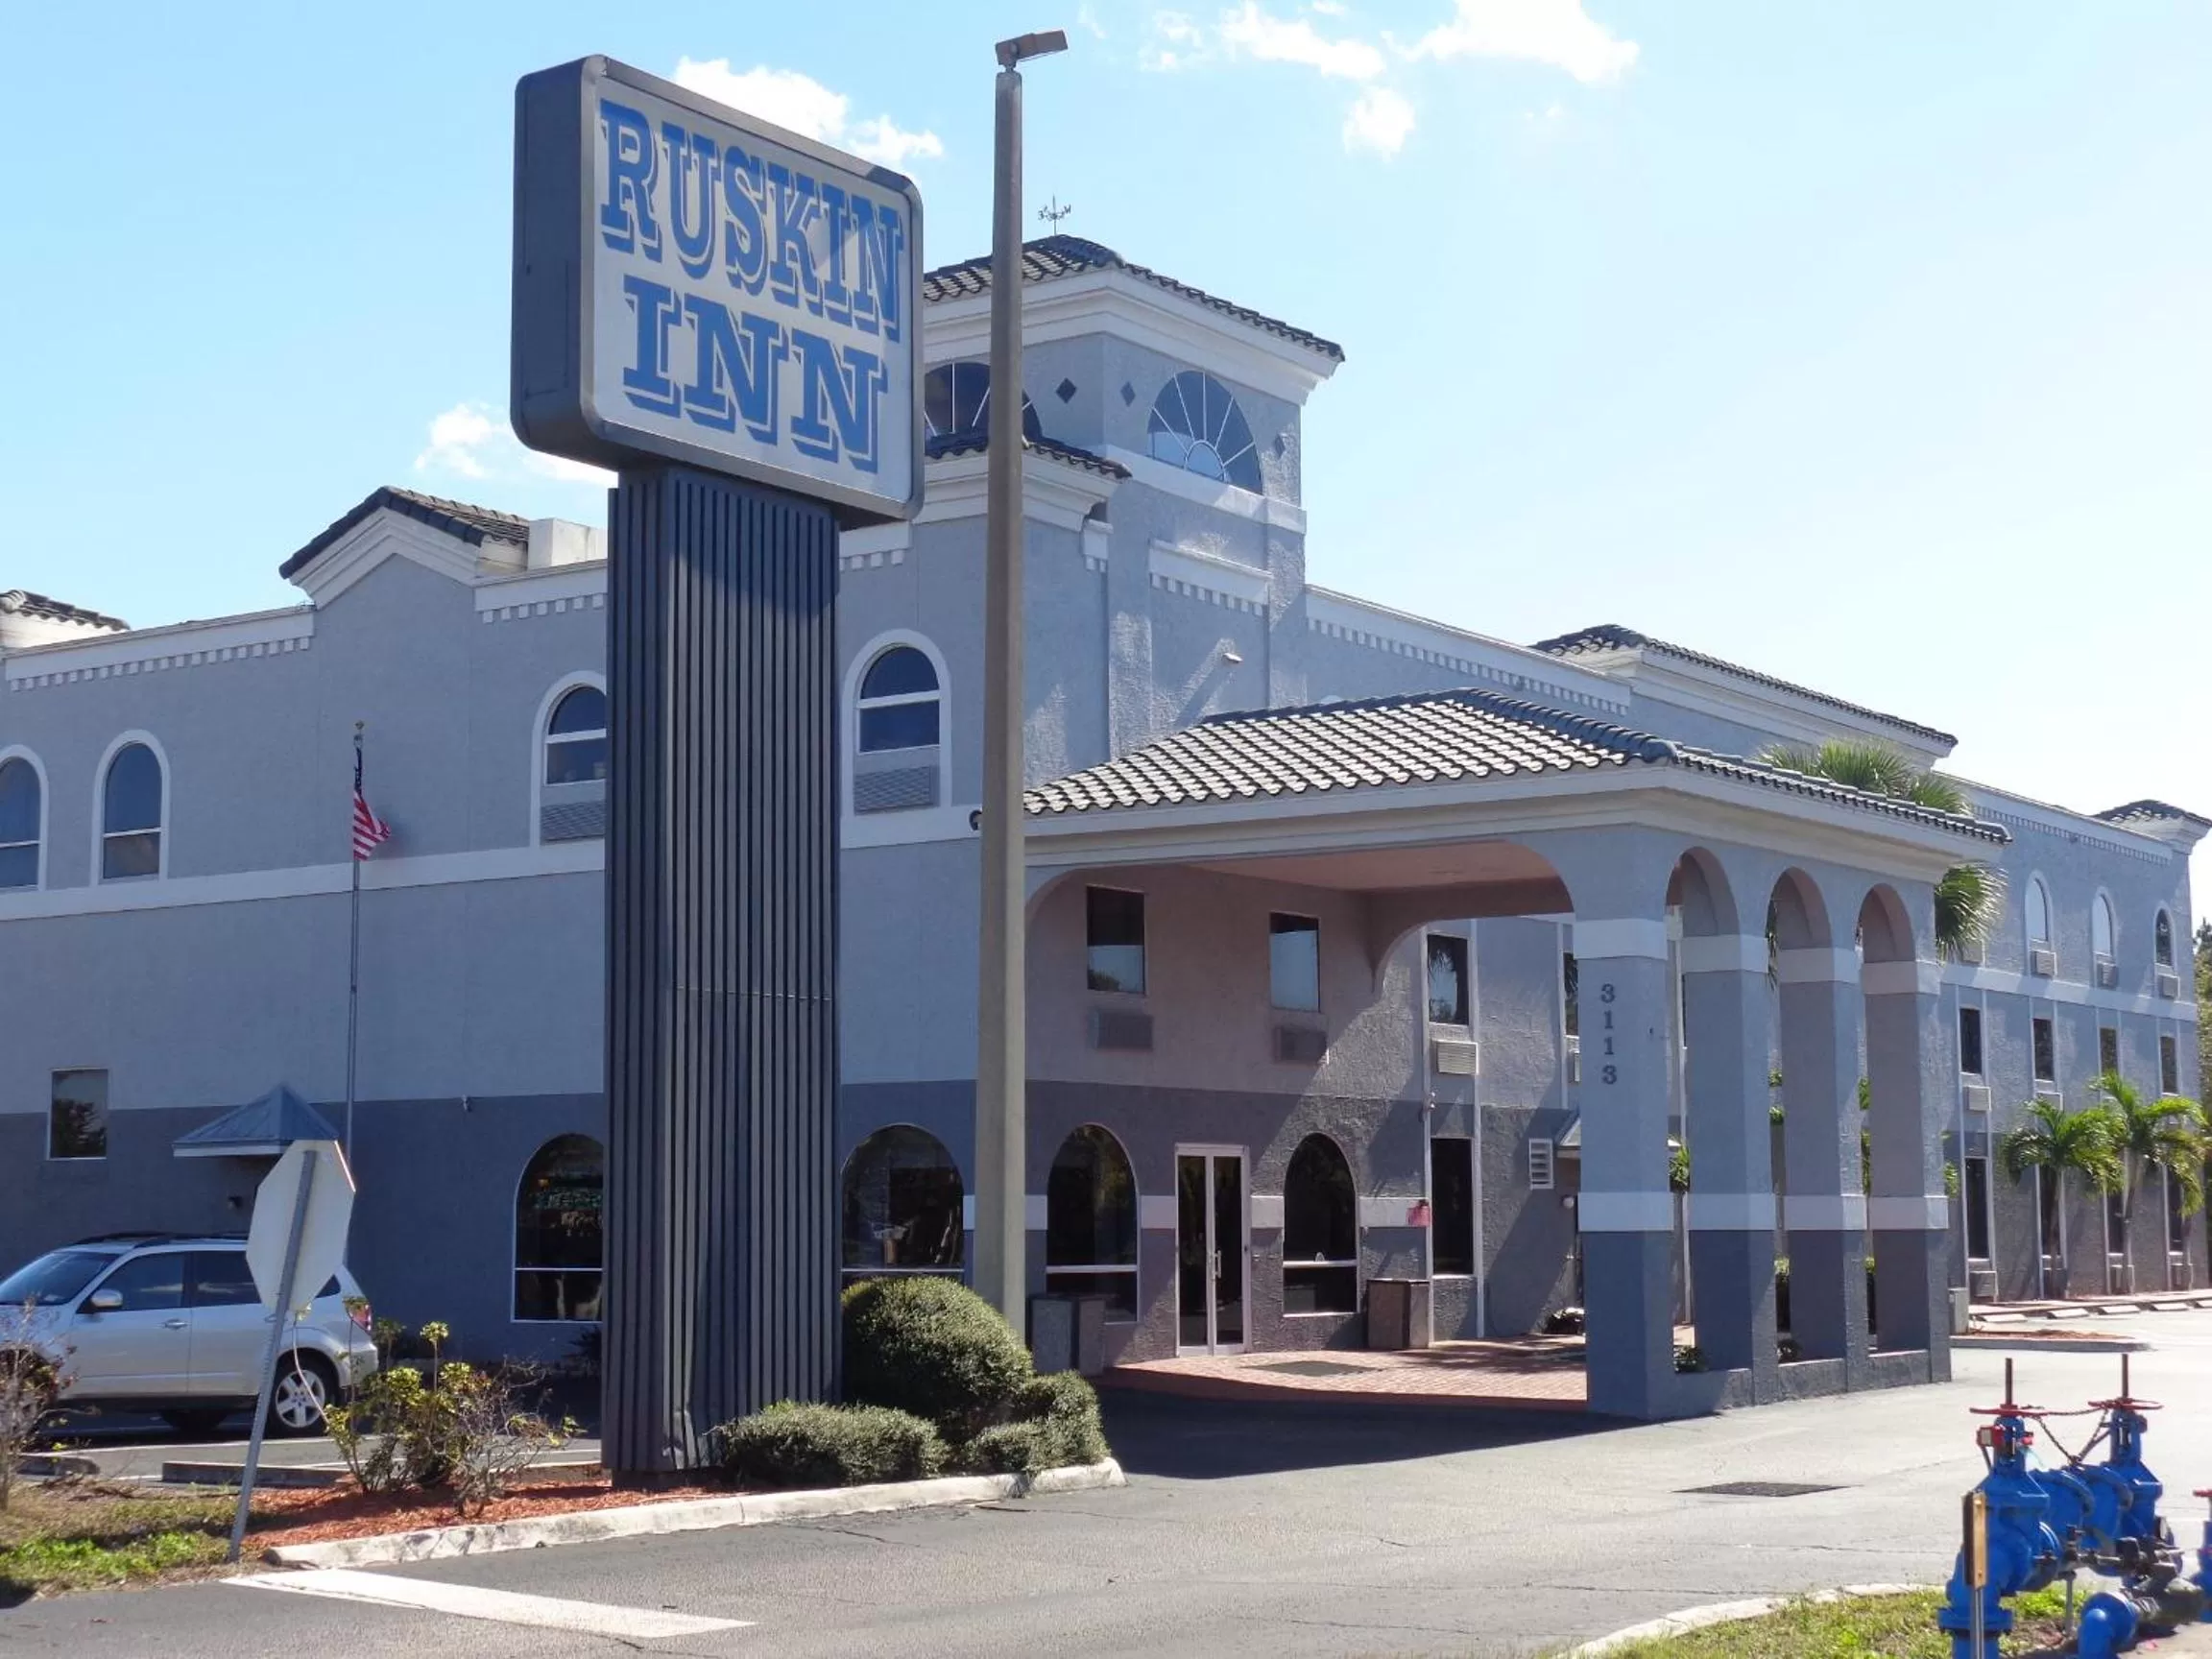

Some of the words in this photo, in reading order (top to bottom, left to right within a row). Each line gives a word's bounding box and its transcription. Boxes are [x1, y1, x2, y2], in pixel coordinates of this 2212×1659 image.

[600, 98, 902, 343] RUSKIN
[623, 275, 887, 473] INN
[1600, 983, 1618, 1084] 3113
